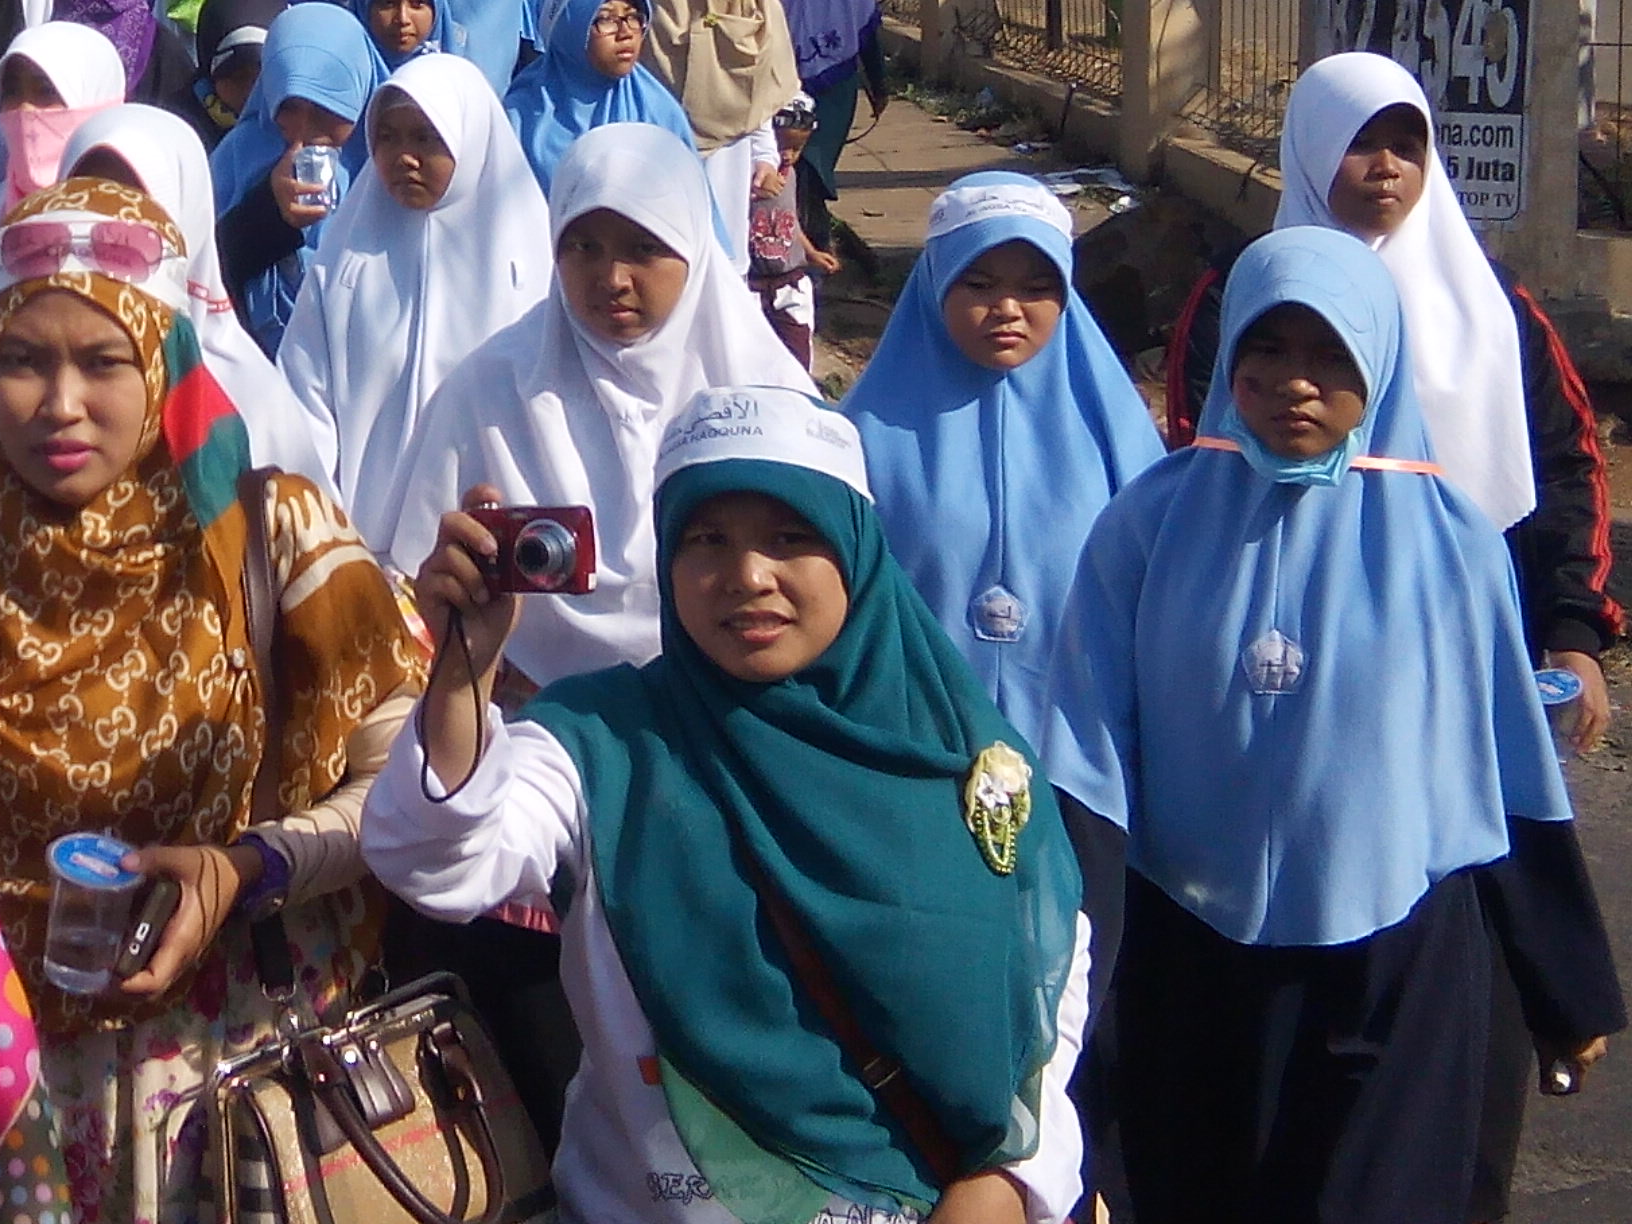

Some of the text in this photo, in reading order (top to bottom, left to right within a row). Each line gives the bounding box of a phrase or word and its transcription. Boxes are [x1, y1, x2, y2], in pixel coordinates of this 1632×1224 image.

[1438, 122, 1515, 149] na.com
[1465, 157, 1516, 183] Juta
[1496, 193, 1515, 206] TV
